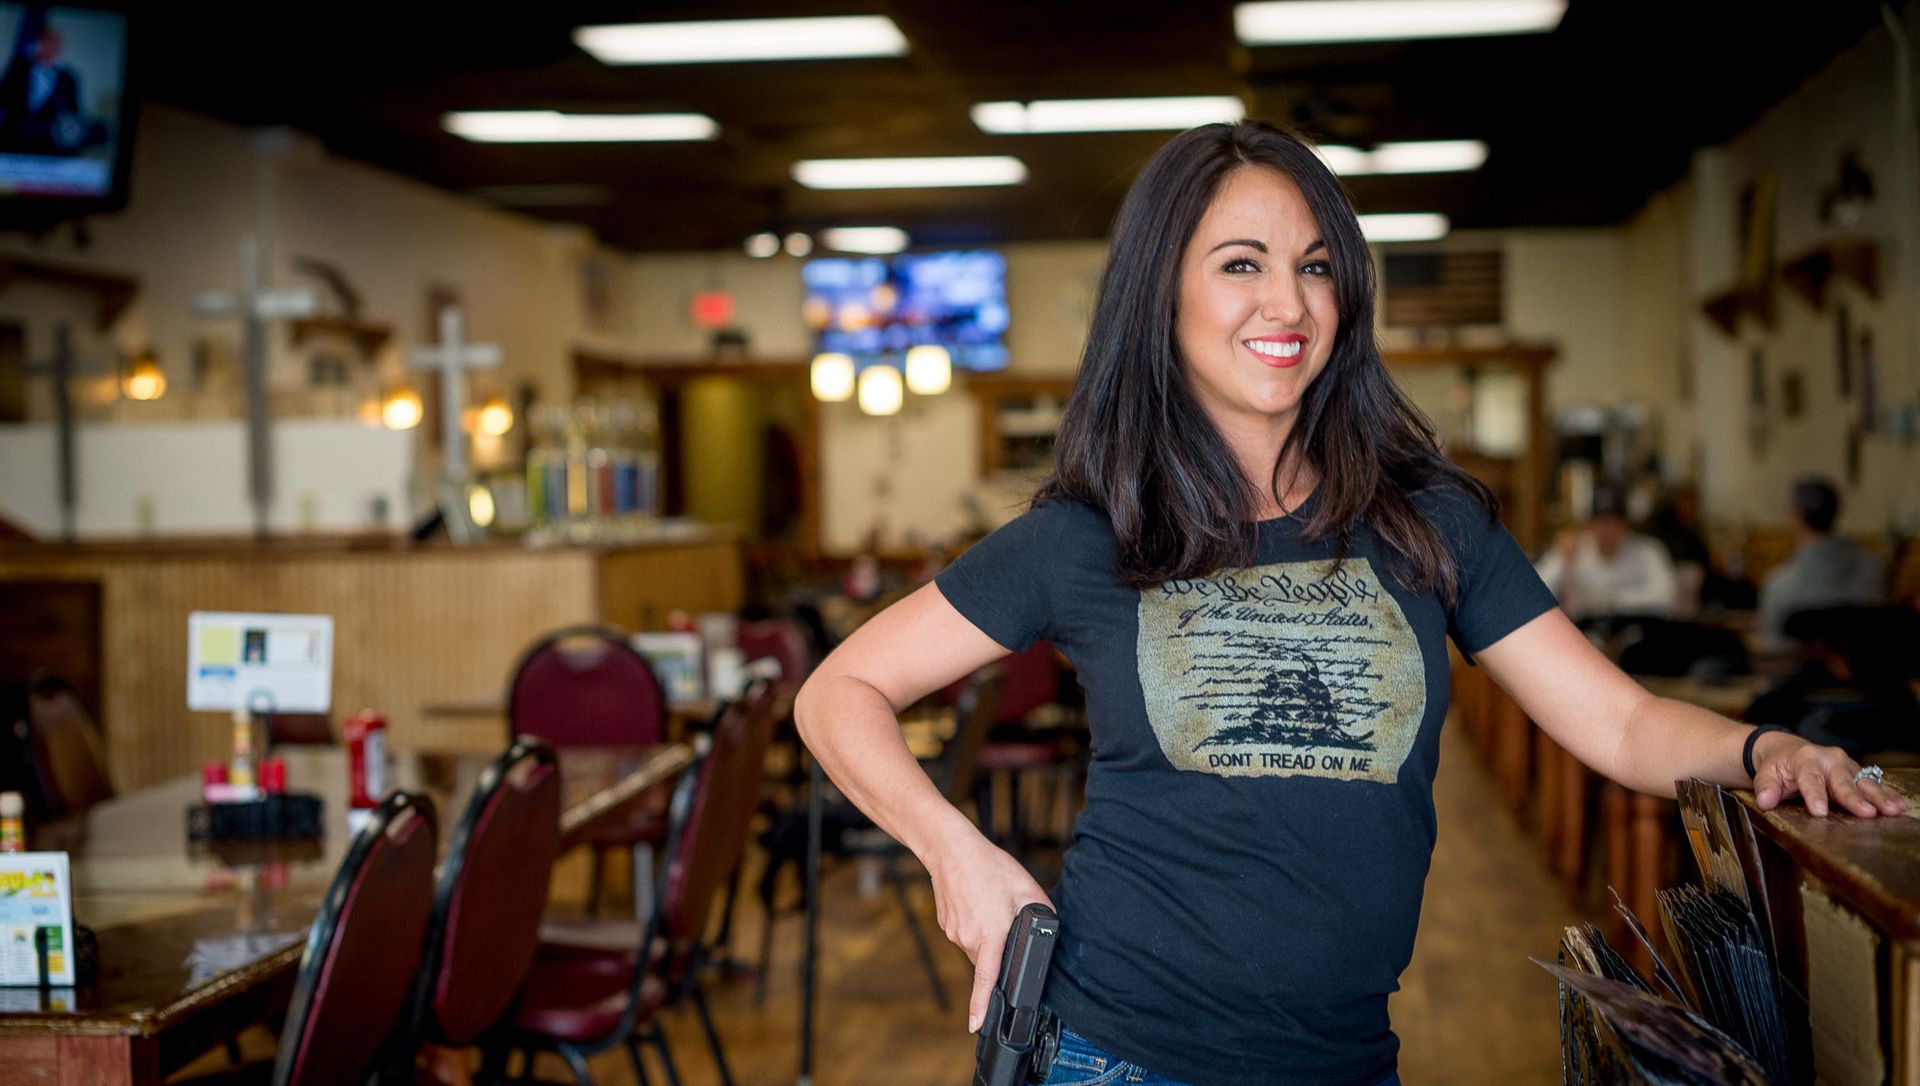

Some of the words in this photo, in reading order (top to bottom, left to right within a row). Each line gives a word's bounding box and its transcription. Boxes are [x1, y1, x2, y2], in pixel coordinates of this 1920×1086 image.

[1260, 568, 1378, 608] People
[1178, 603, 1209, 629] of
[1201, 603, 1233, 620] the
[1236, 607, 1303, 623] United
[1303, 607, 1373, 629] States,
[1209, 753, 1253, 768] DONT
[1260, 753, 1316, 770] TREAD
[1321, 756, 1344, 771] ON
[1350, 757, 1373, 773] ME
